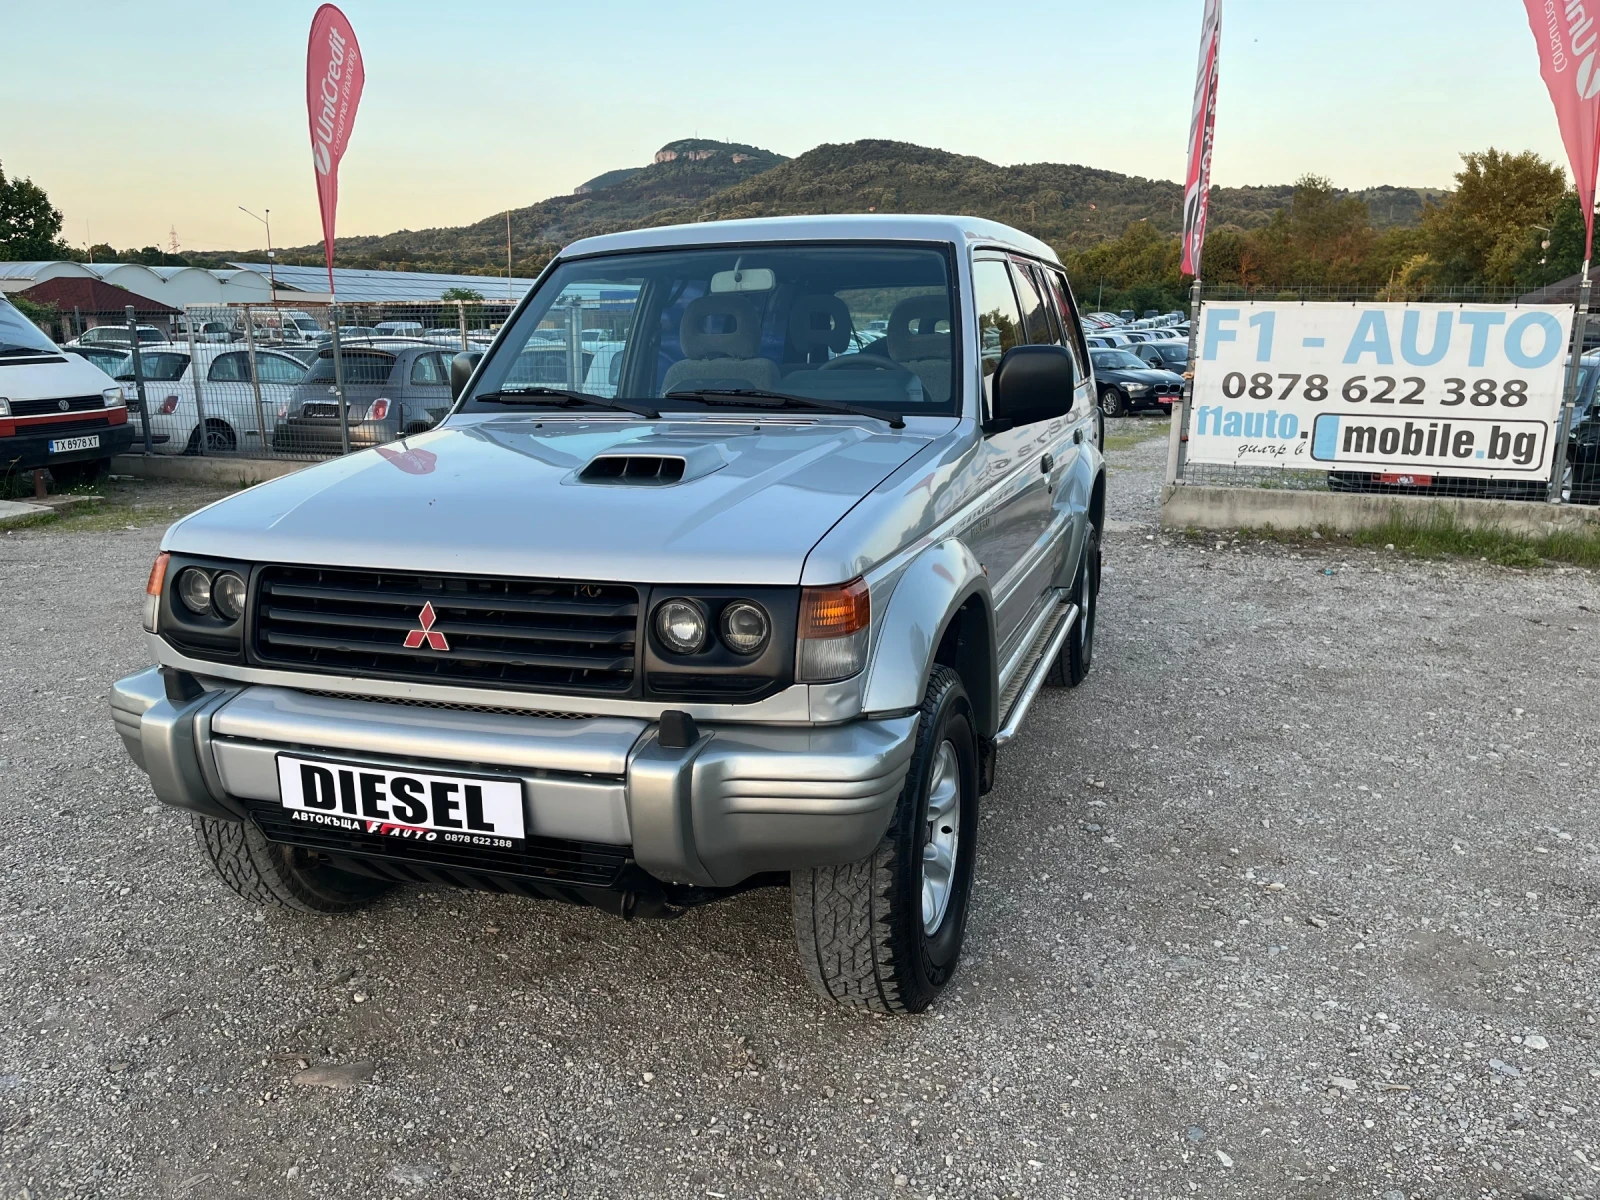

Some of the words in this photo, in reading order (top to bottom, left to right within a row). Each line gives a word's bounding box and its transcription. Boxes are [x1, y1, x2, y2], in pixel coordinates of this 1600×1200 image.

[317, 26, 346, 145] UniCredit
[1202, 308, 1276, 362] F1
[1302, 337, 1325, 348] -
[1341, 309, 1564, 369] AUTO
[1221, 371, 1329, 402] 0878
[1341, 375, 1427, 405] 622
[1439, 377, 1529, 408] 388
[1342, 422, 1537, 465] mobile.bg
[299, 763, 495, 833] DIESEL
[291, 810, 361, 830] АВТОКЪЩА
[390, 827, 438, 841] AUTO
[444, 833, 471, 843] 0878
[472, 836, 491, 846] 622
[492, 838, 512, 848] 388
